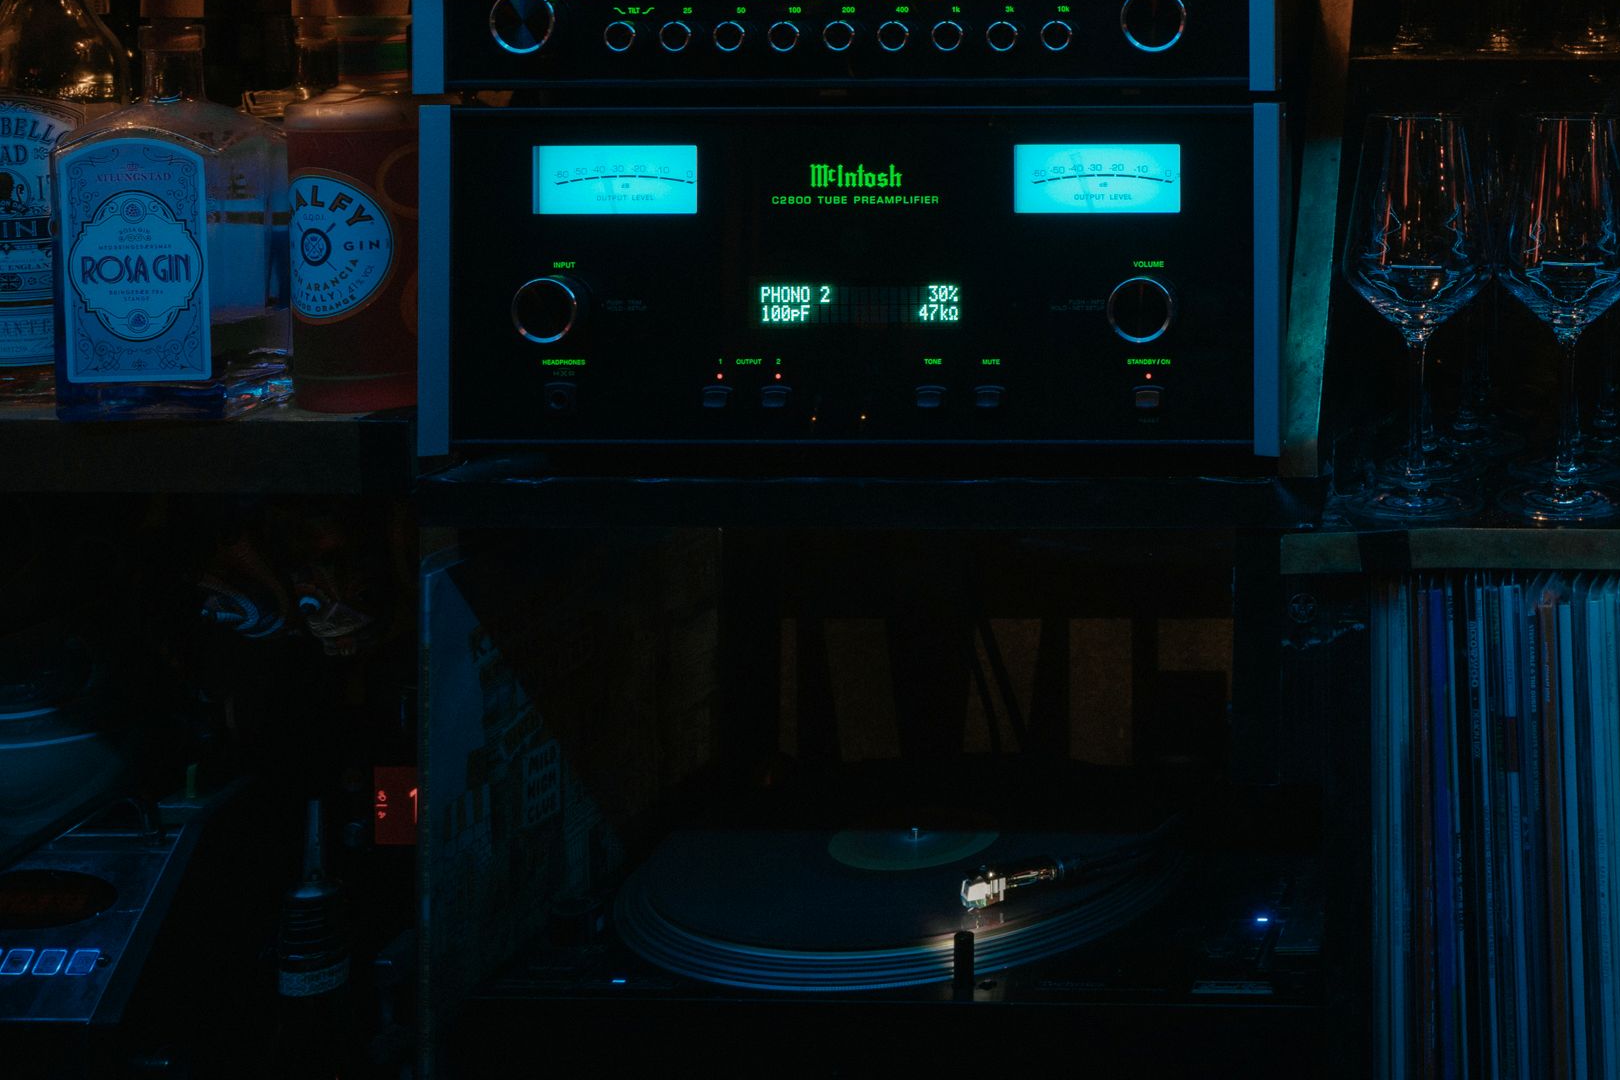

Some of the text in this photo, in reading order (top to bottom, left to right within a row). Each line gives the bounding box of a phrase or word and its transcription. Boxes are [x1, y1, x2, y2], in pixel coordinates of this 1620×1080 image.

[1057, 5, 1070, 13] 10k
[631, 164, 693, 179] -20 0
[810, 163, 902, 188] McIntosh
[1087, 163, 1172, 178] -30 -20 -10 0
[596, 193, 655, 202] OUTPUT LEVEL
[771, 195, 939, 205] C2800 TUBE PREAMPLIFIER
[1073, 193, 1132, 201] OUTPUT LEVEL
[289, 183, 375, 227] ALFY
[342, 239, 381, 251] GIN
[80, 253, 193, 285] ROSA GIN
[553, 261, 576, 269] INPUT
[1132, 260, 1165, 268] VOLUME
[305, 258, 360, 292] ARANCIA
[760, 285, 959, 303] PHONO 2 30%
[762, 304, 959, 322] 100pF 47kΩ
[541, 358, 587, 366] HEADPHONES
[735, 358, 763, 366] OUTPUT
[923, 358, 1001, 366] TONE MUTE
